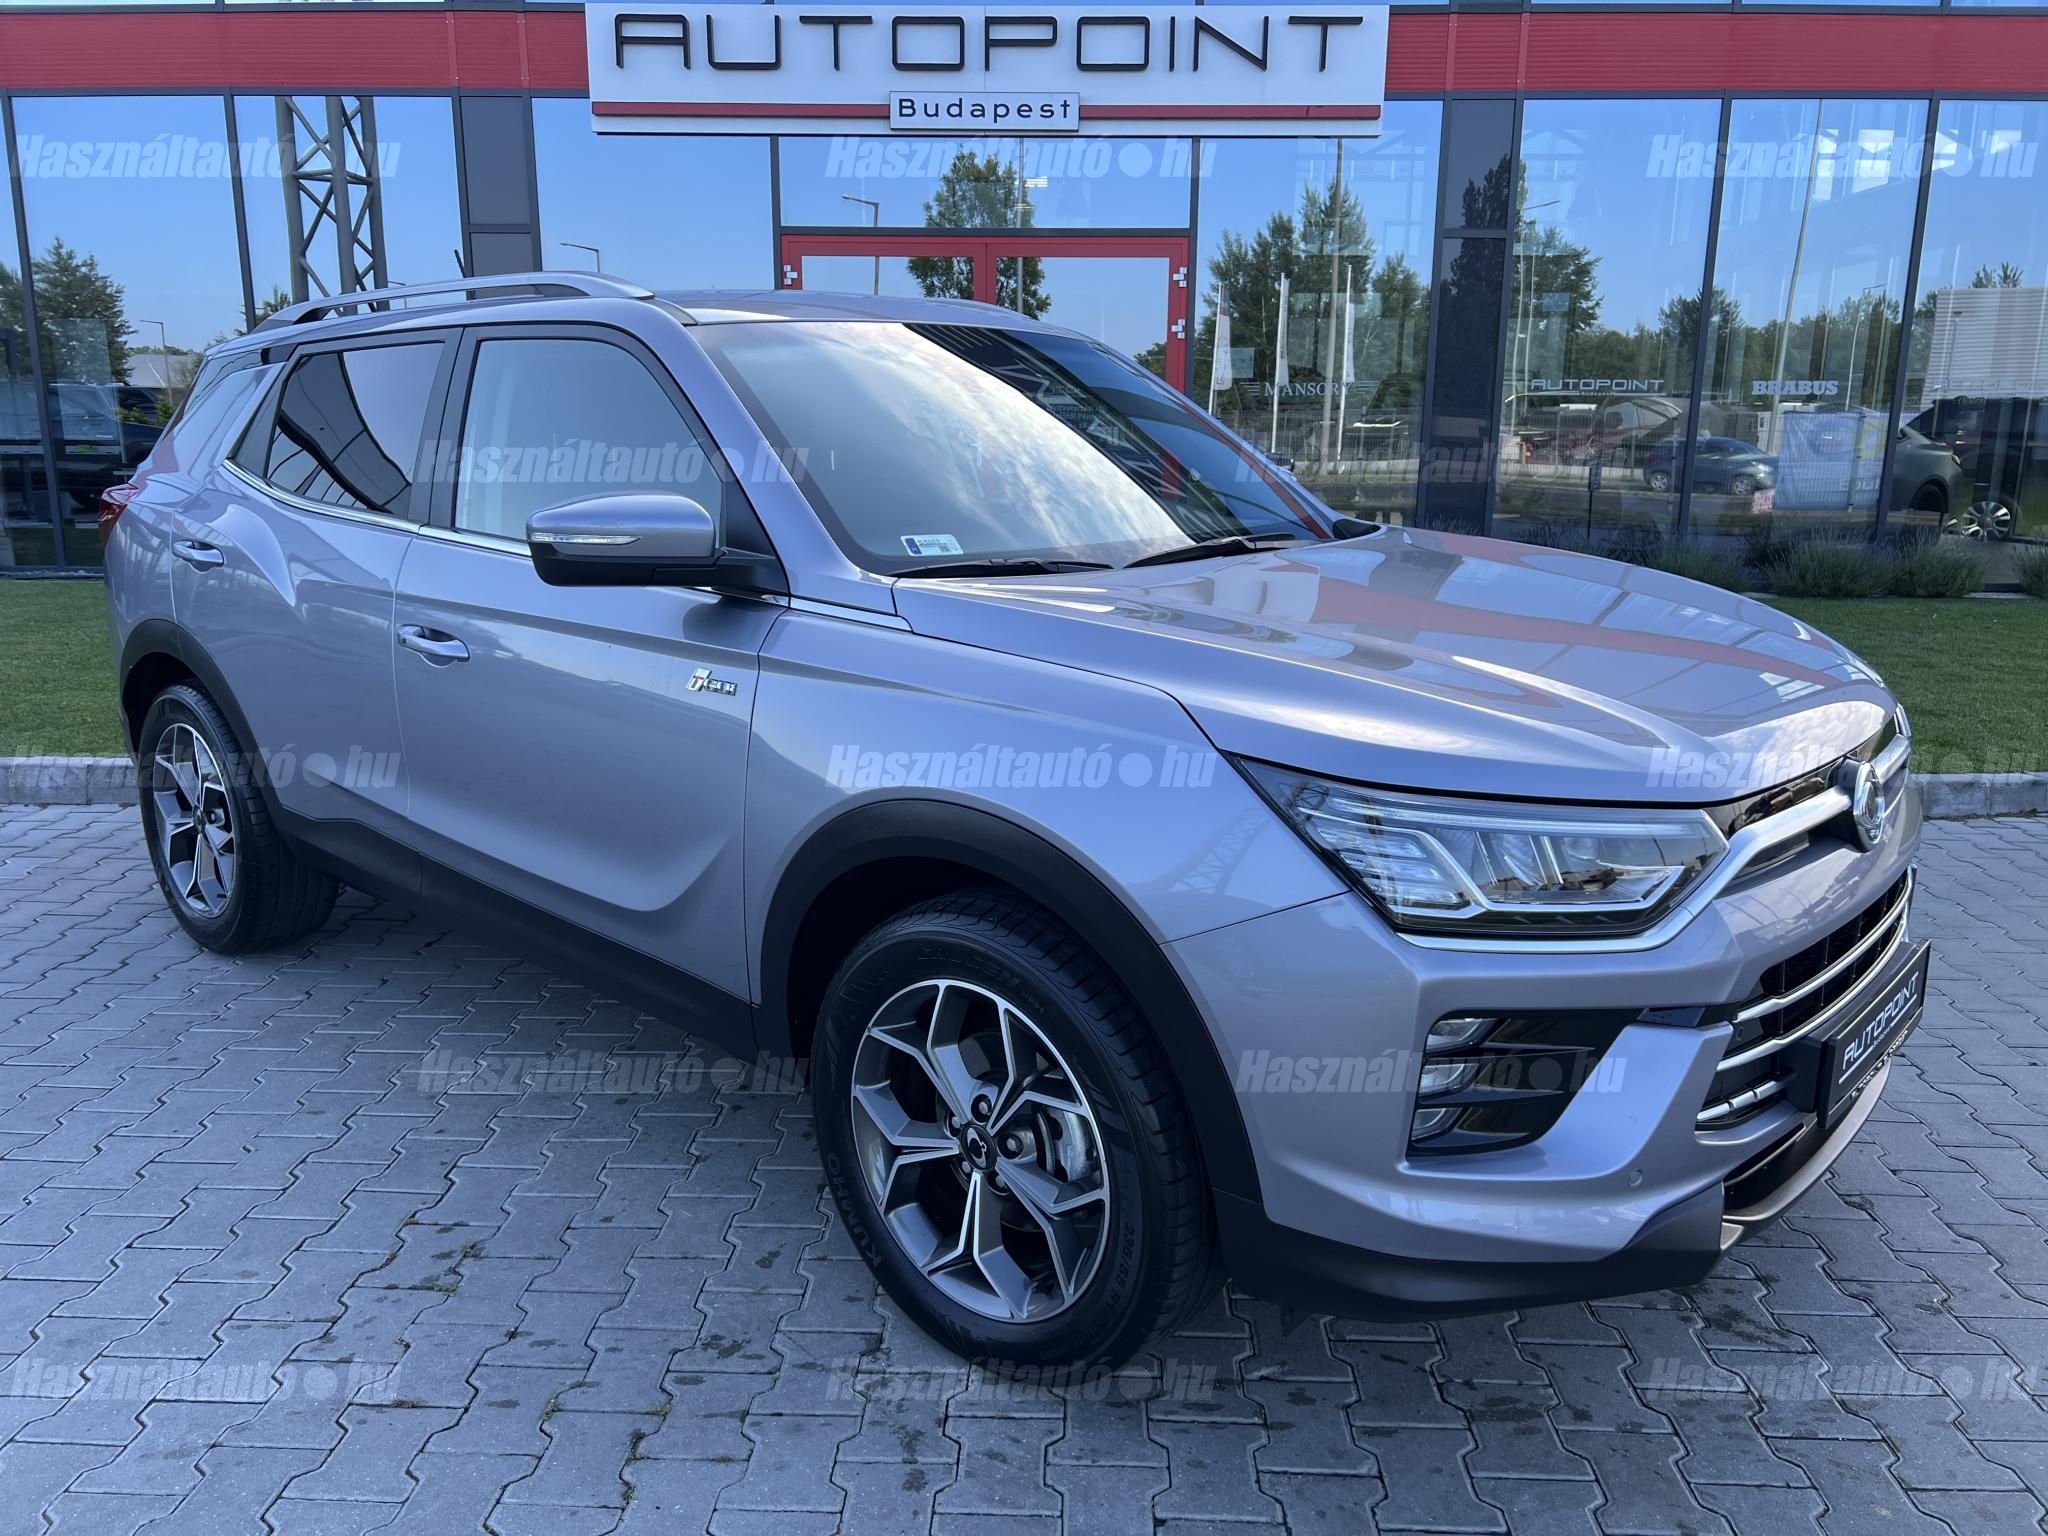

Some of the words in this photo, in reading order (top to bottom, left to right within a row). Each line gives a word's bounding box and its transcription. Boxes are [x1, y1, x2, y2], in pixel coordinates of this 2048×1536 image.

[614, 13, 1364, 72] AUTOPOINT
[898, 97, 1073, 124] Budapest
[1264, 382, 1351, 396] MANSORY
[1530, 378, 1665, 391] AUTOPOINT
[1752, 380, 1839, 395] BRABUS
[1842, 971, 1919, 1070] AUTOPOINT
[827, 1152, 883, 1267] KUMHO
